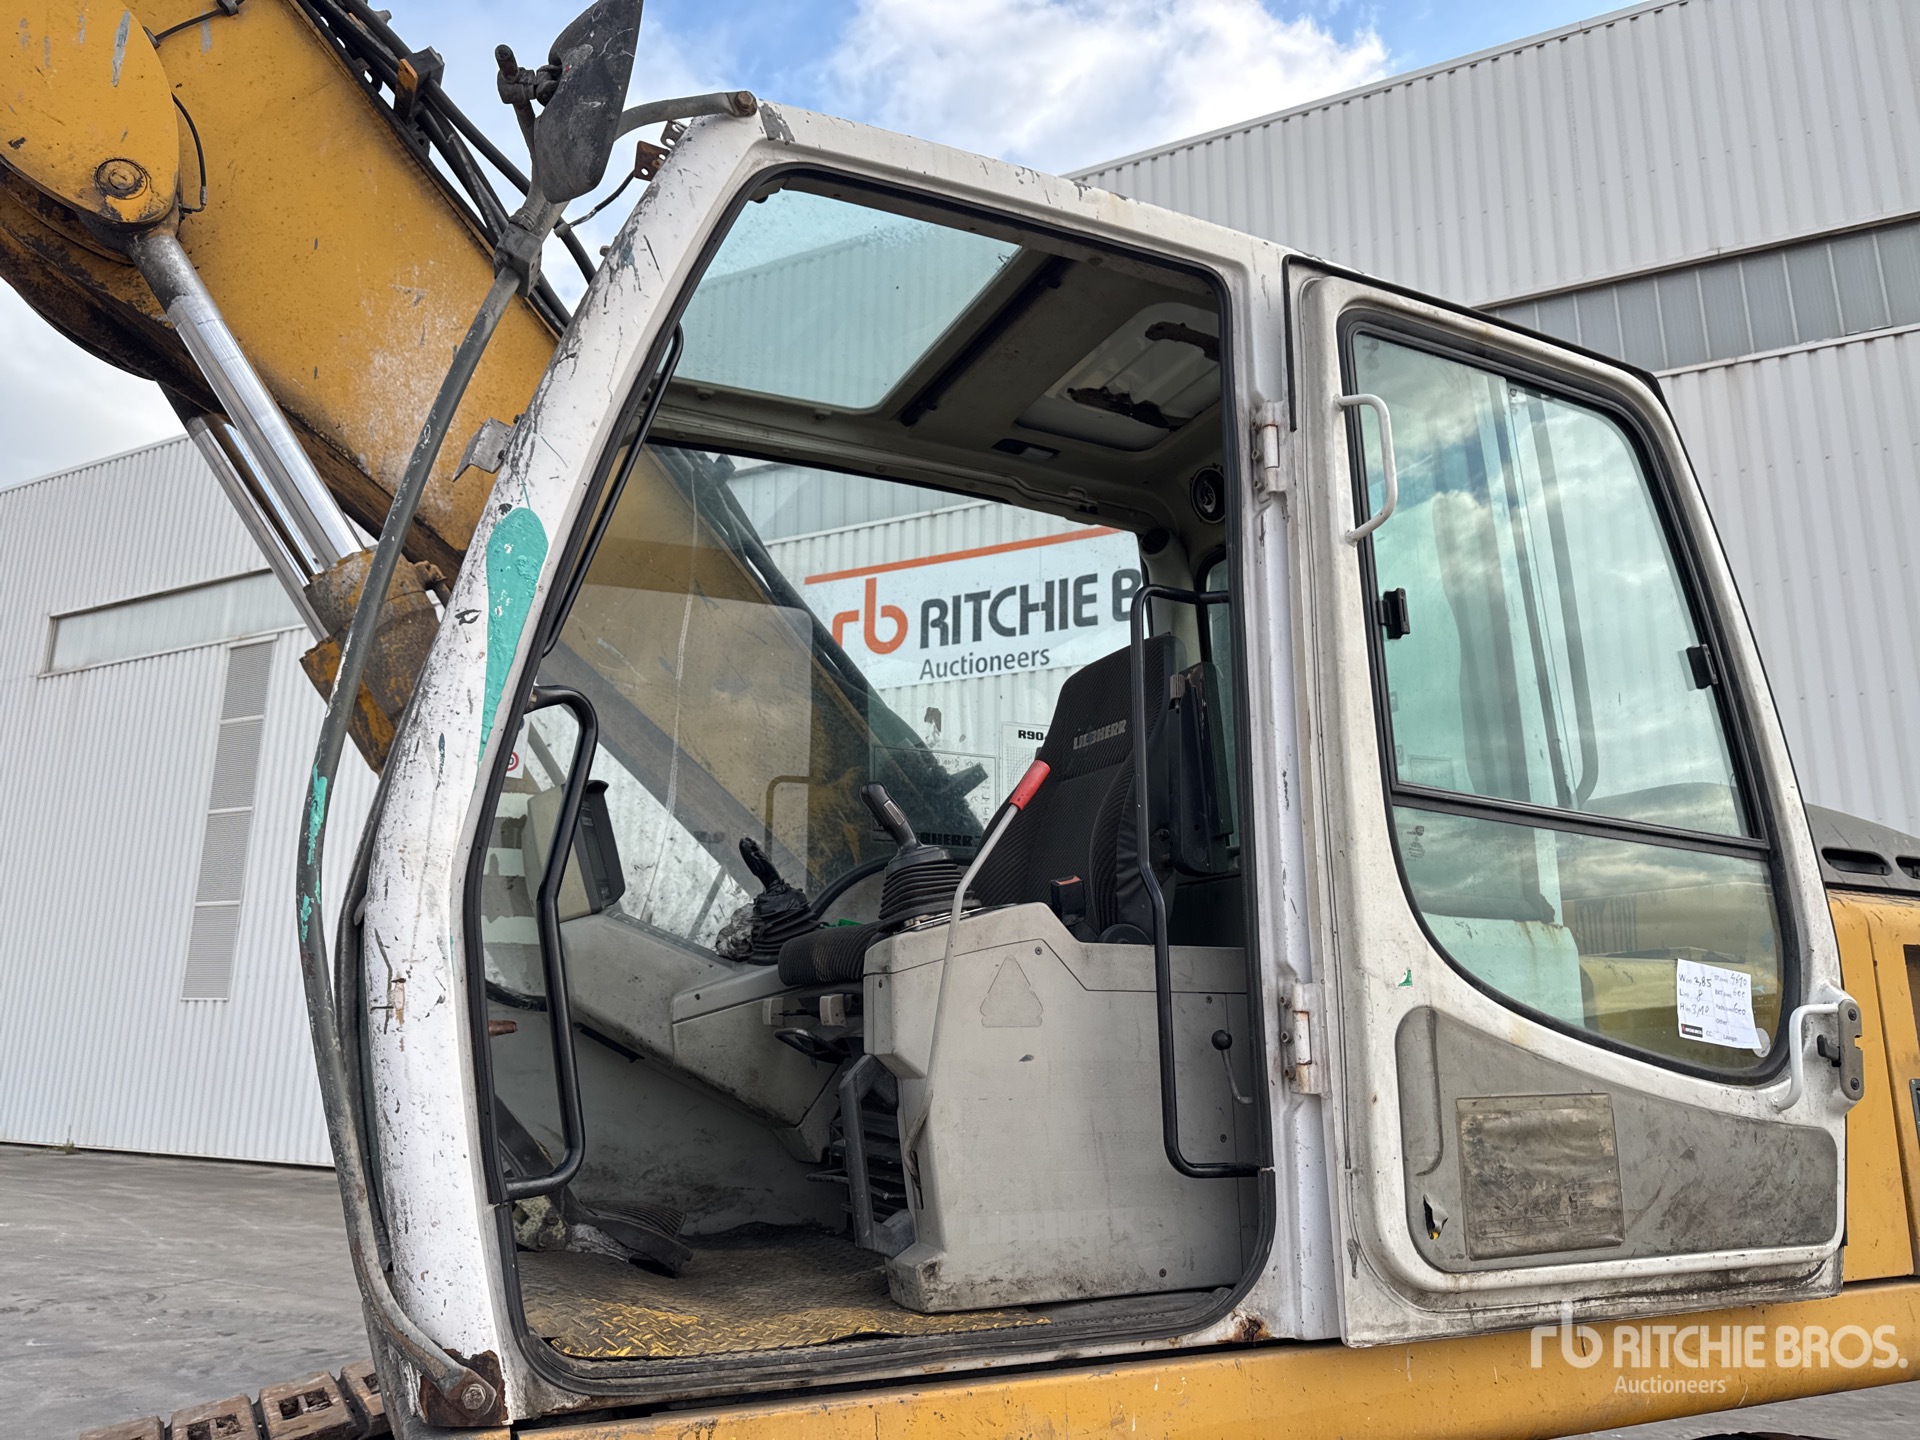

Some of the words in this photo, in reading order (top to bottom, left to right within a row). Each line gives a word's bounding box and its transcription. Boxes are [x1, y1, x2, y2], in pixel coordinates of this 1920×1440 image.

[919, 573, 1099, 649] RITCHIE
[919, 648, 1051, 681] Auctioneers
[1018, 730, 1045, 741] R90
[915, 832, 973, 847] BHERR
